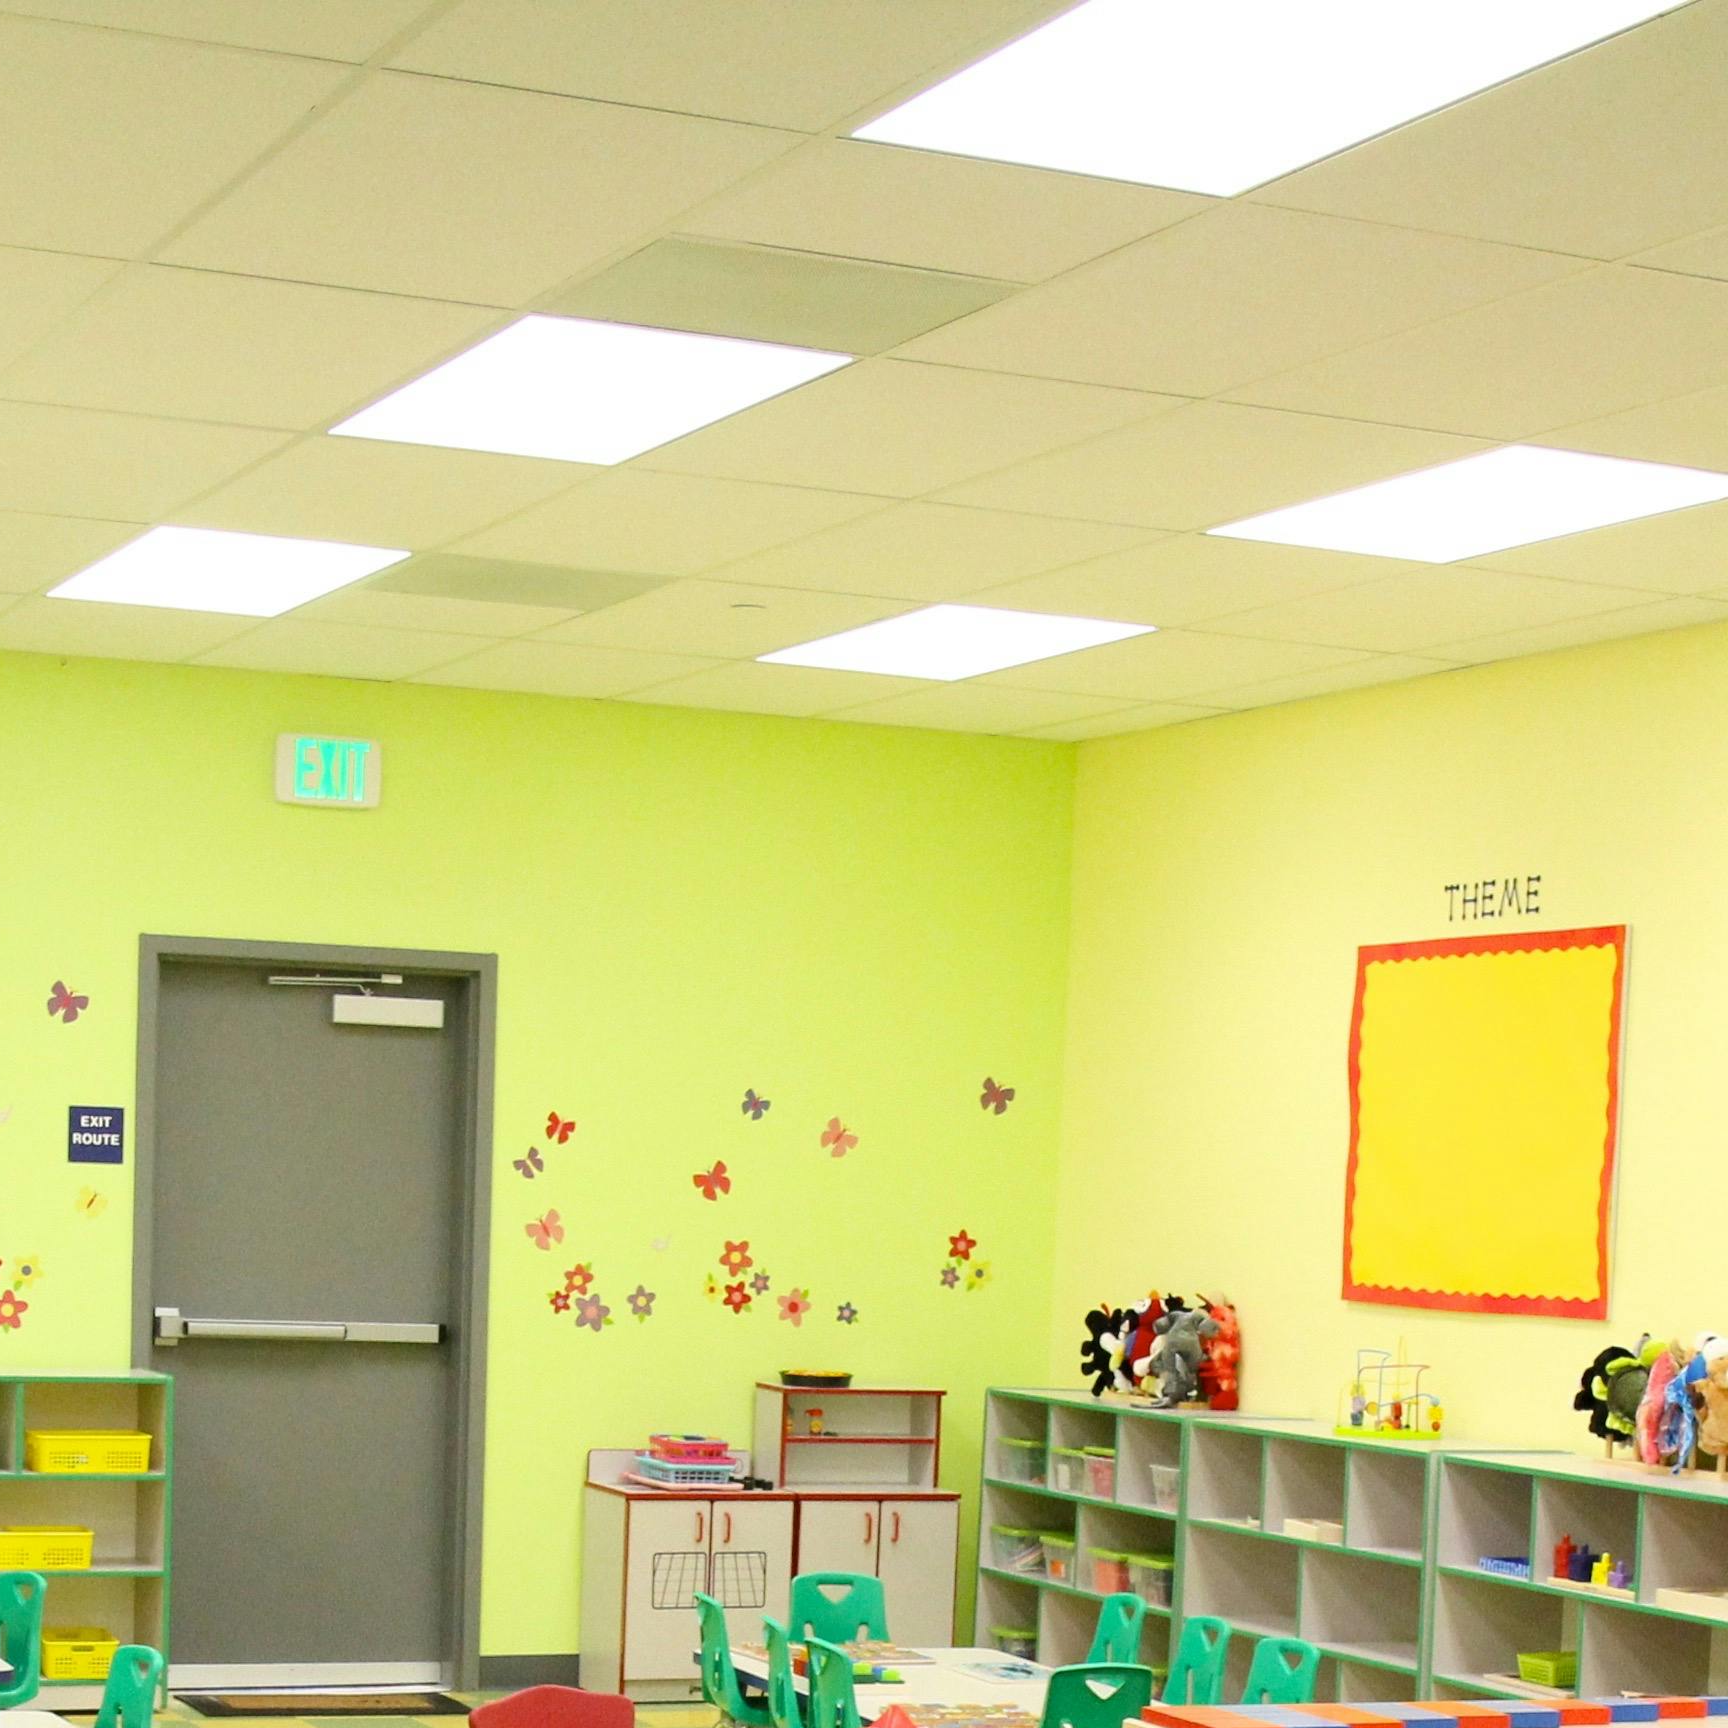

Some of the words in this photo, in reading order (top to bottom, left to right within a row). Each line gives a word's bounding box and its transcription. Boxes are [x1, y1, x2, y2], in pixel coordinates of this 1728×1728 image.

[294, 738, 370, 801] EXIT
[1444, 875, 1541, 922] THEME
[80, 1115, 112, 1129] EXIT
[72, 1133, 120, 1147] ROUTE
